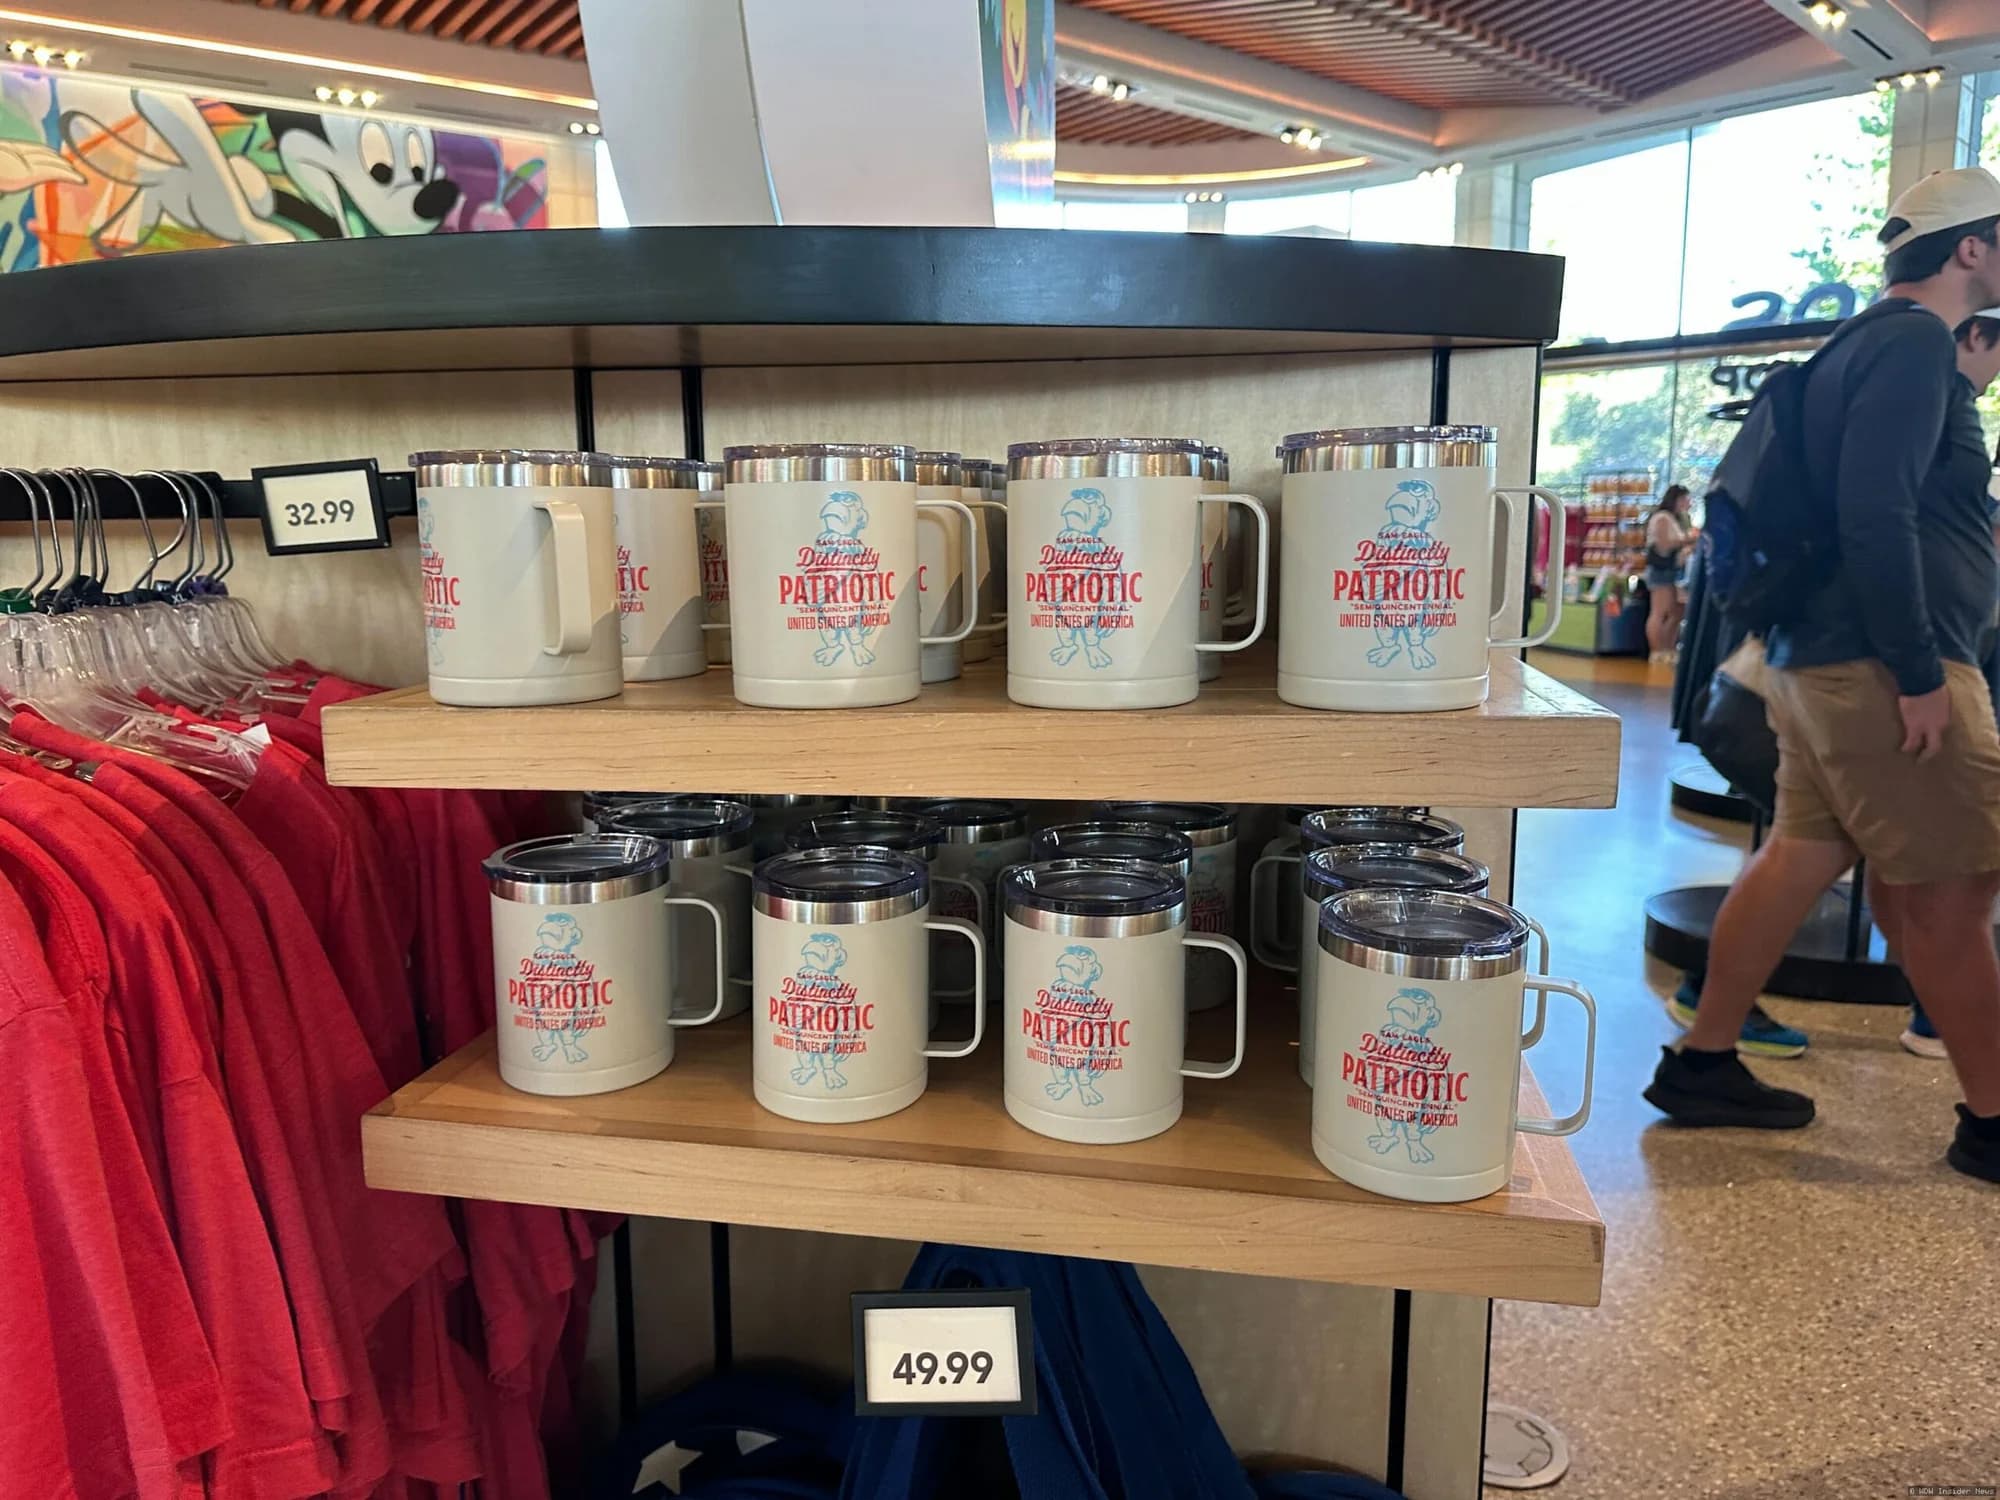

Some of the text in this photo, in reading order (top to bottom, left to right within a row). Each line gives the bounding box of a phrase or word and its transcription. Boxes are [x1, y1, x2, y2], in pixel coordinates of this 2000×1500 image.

[285, 500, 354, 526] 32.99
[796, 546, 880, 573] Distinctly
[1038, 545, 1124, 572] Distinctly
[1354, 540, 1450, 568] Distinctly
[779, 571, 895, 605] PATRIOTIC
[1025, 571, 1142, 603] PATRIOTIC
[1333, 568, 1465, 601] PATRIOTIC
[7, 604, 16, 614] L
[788, 613, 891, 630] UNITED STATES OF AMERICA
[1031, 614, 1134, 629] UNITED STATES OF AMERICA
[1340, 613, 1457, 628] UNITED STATES OF AMERICA
[519, 957, 595, 982] Distinctly
[509, 978, 613, 1008] PATRIOTIC
[781, 976, 858, 1005] Distinctly
[1035, 988, 1114, 1020] Distinctly
[514, 1016, 606, 1030] UNITED STATES OF AMERICA
[769, 996, 874, 1030] PATRIOTIC
[1022, 1007, 1130, 1047] PATRIOTIC
[773, 1034, 867, 1053] UNITED STATES OF AMERICA
[1359, 1032, 1452, 1071] Distinctly
[1027, 1046, 1122, 1070] UNITED STATES OF AMERICA
[1342, 1052, 1469, 1102] PATRIOTIC
[1346, 1094, 1458, 1127] UNITED STATES OF AMERICA
[893, 1351, 993, 1385] 49.99
